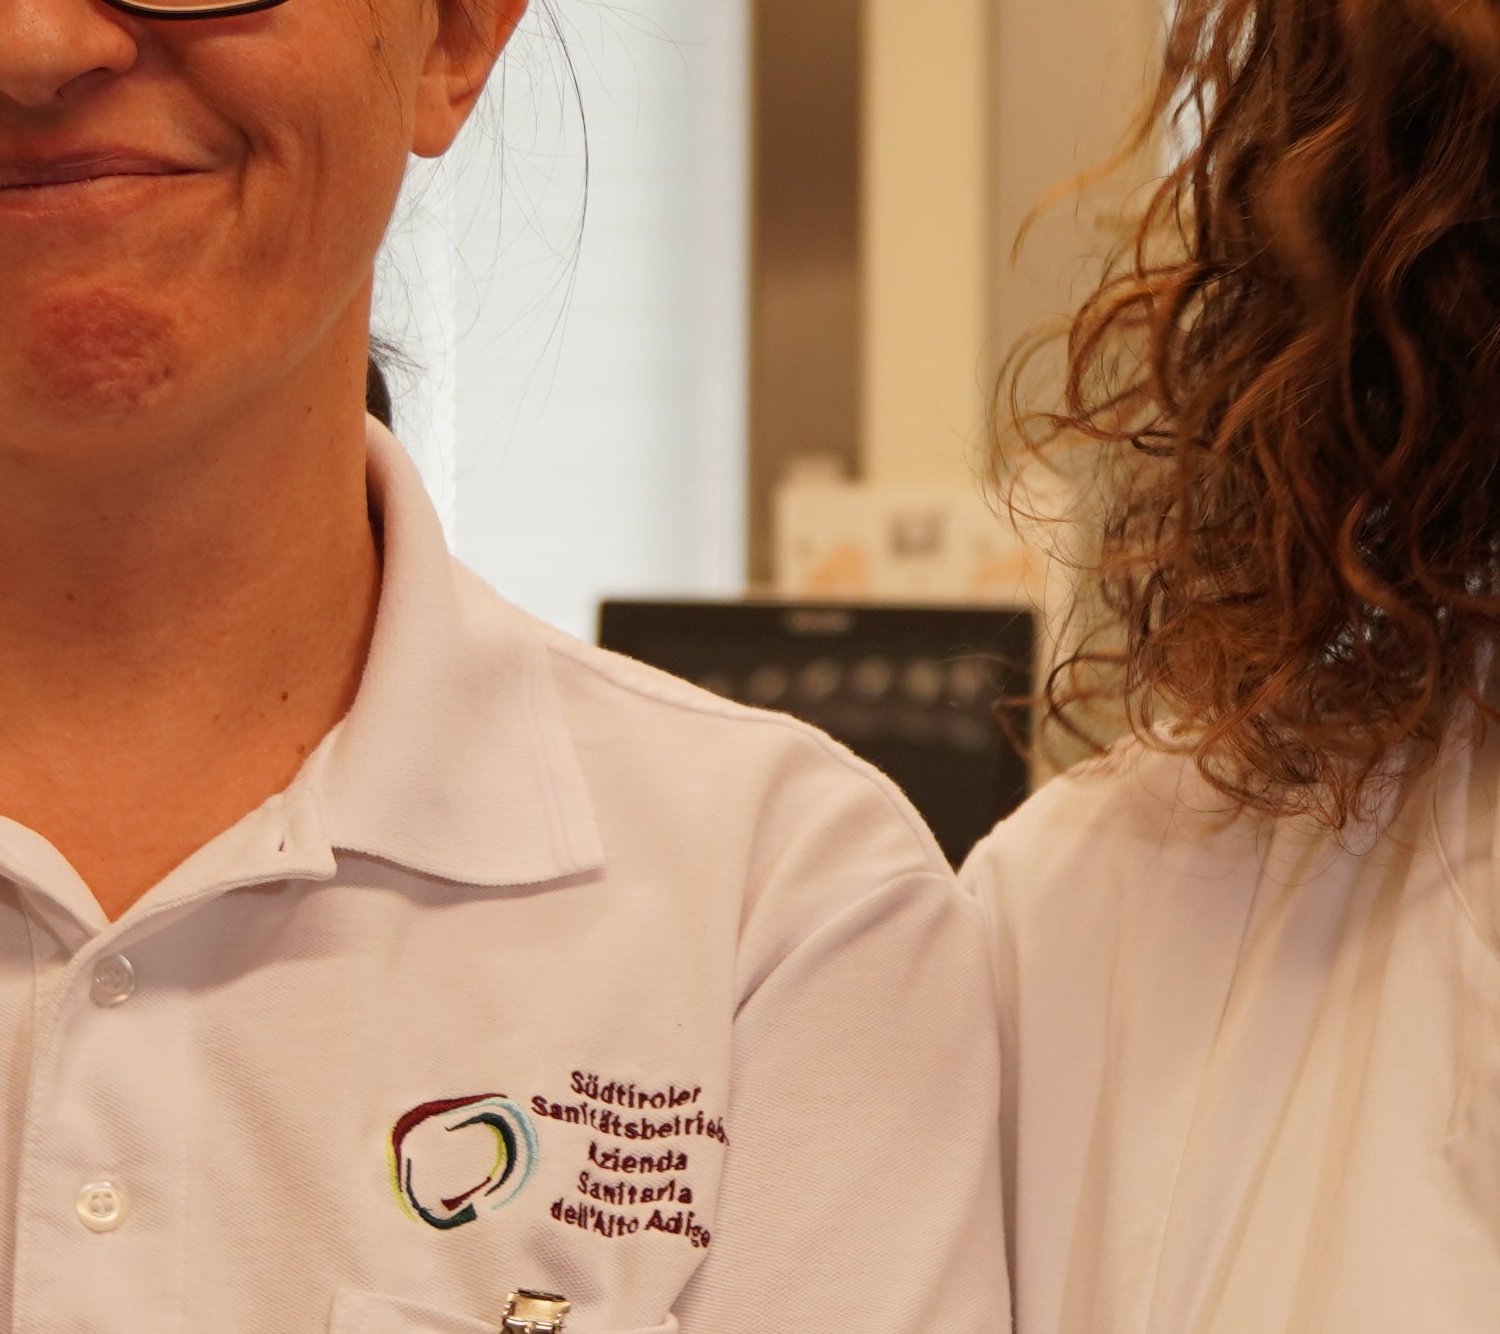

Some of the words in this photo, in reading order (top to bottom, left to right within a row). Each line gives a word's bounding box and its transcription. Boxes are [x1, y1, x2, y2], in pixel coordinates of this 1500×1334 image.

[570, 1070, 702, 1109] Südtiroler
[577, 1170, 693, 1205] Sanitaria
[550, 1197, 640, 1238] dell'Alto
[644, 1209, 712, 1248] Adige
